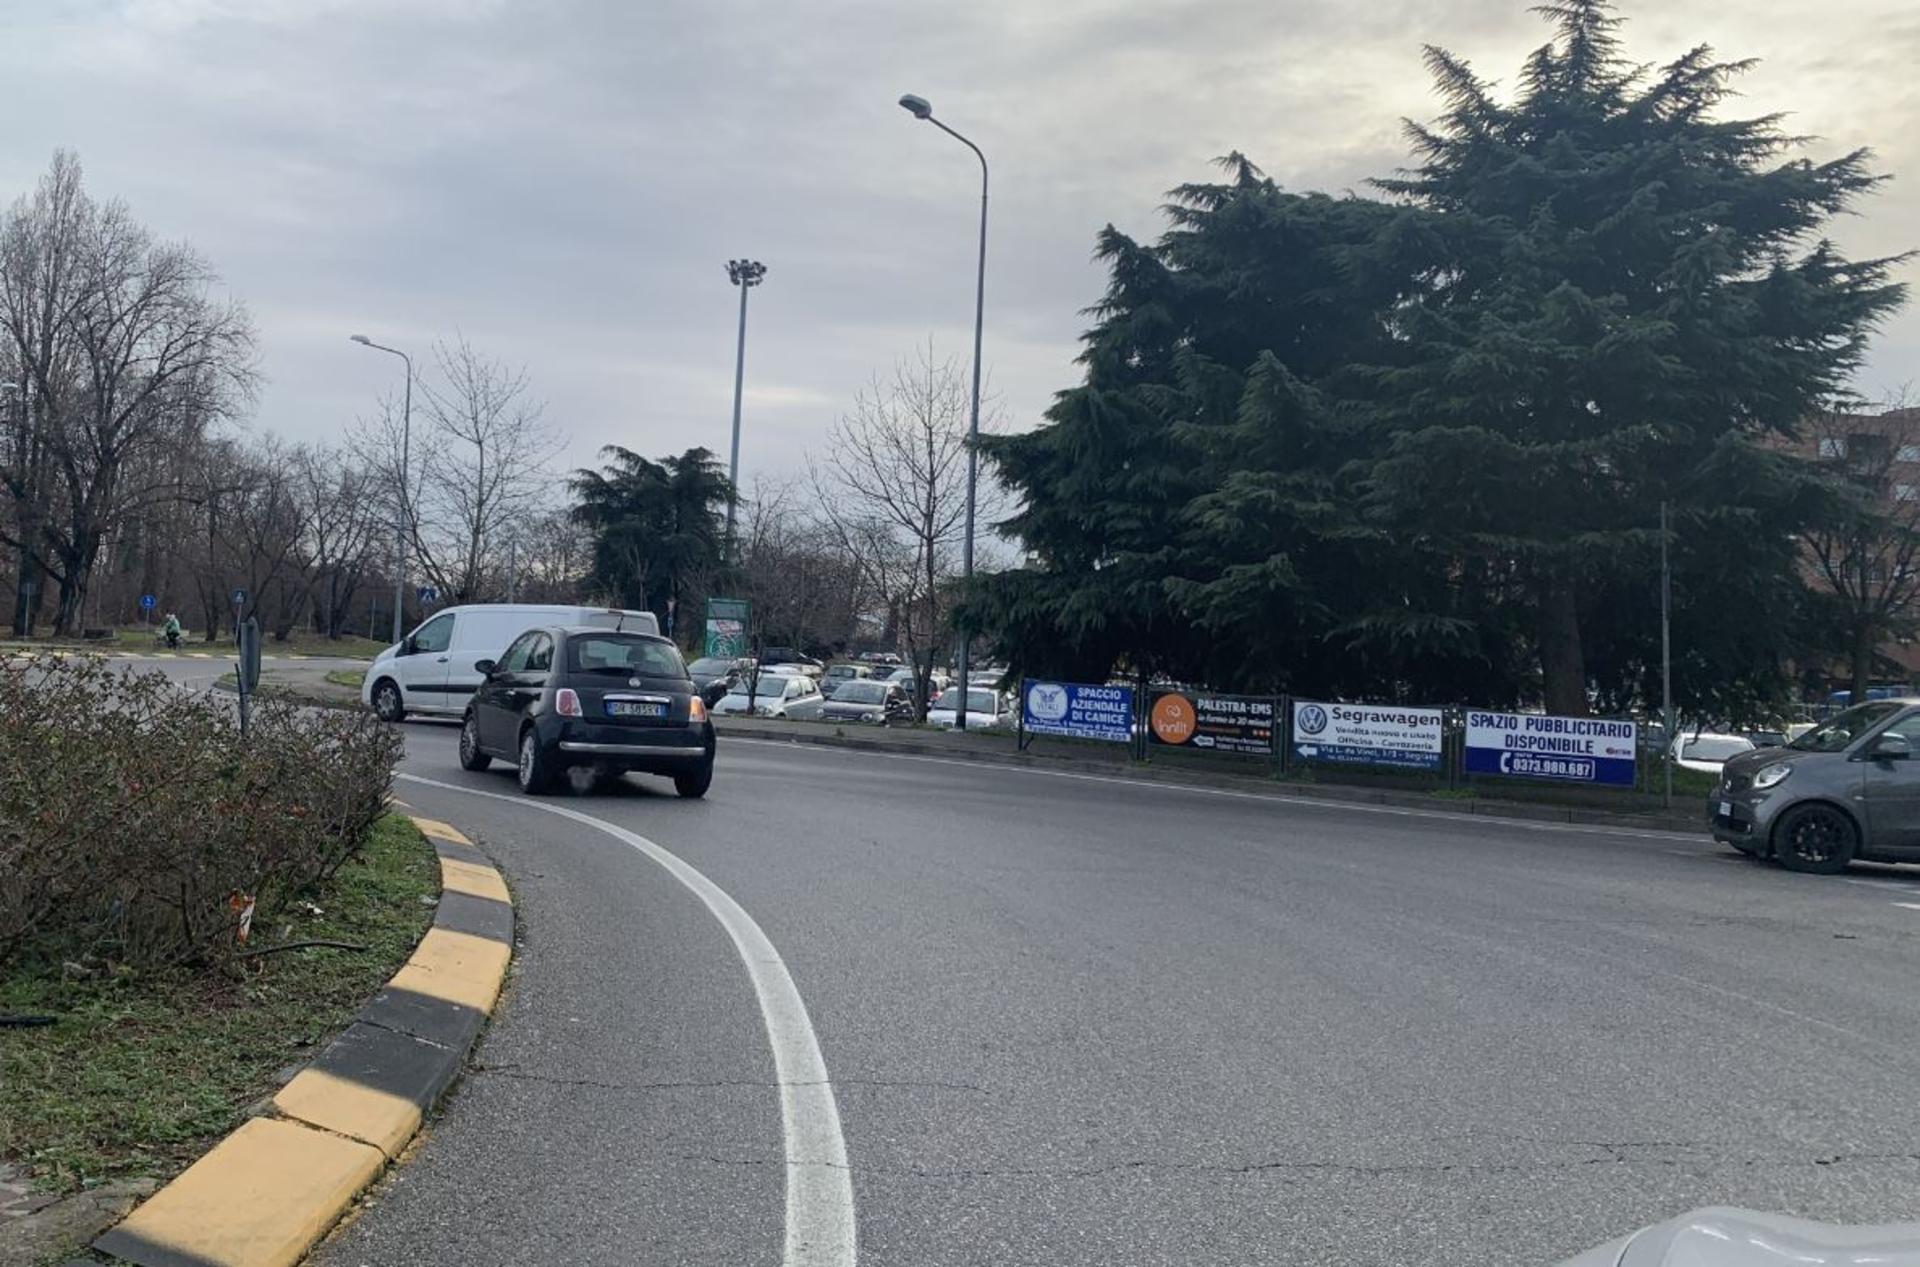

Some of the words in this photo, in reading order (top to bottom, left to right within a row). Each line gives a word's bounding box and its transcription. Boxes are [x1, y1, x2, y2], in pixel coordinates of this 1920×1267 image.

[1077, 687, 1122, 700] SPACCIO
[1070, 699, 1128, 713] AZIENDALE
[1197, 699, 1272, 714] PALESTRA-EMS
[1071, 711, 1083, 721] DI
[1084, 711, 1125, 724] CAMICE
[1332, 706, 1441, 727] Segrawagen
[1335, 726, 1370, 736] Vendita
[1371, 729, 1400, 739] nuovo
[1409, 731, 1437, 741] usato
[1470, 713, 1518, 731] SPAZIO
[1526, 717, 1632, 739] PUBBLICITARIO
[1337, 737, 1374, 746] Officina
[1504, 734, 1594, 754] DISPONIBILE
